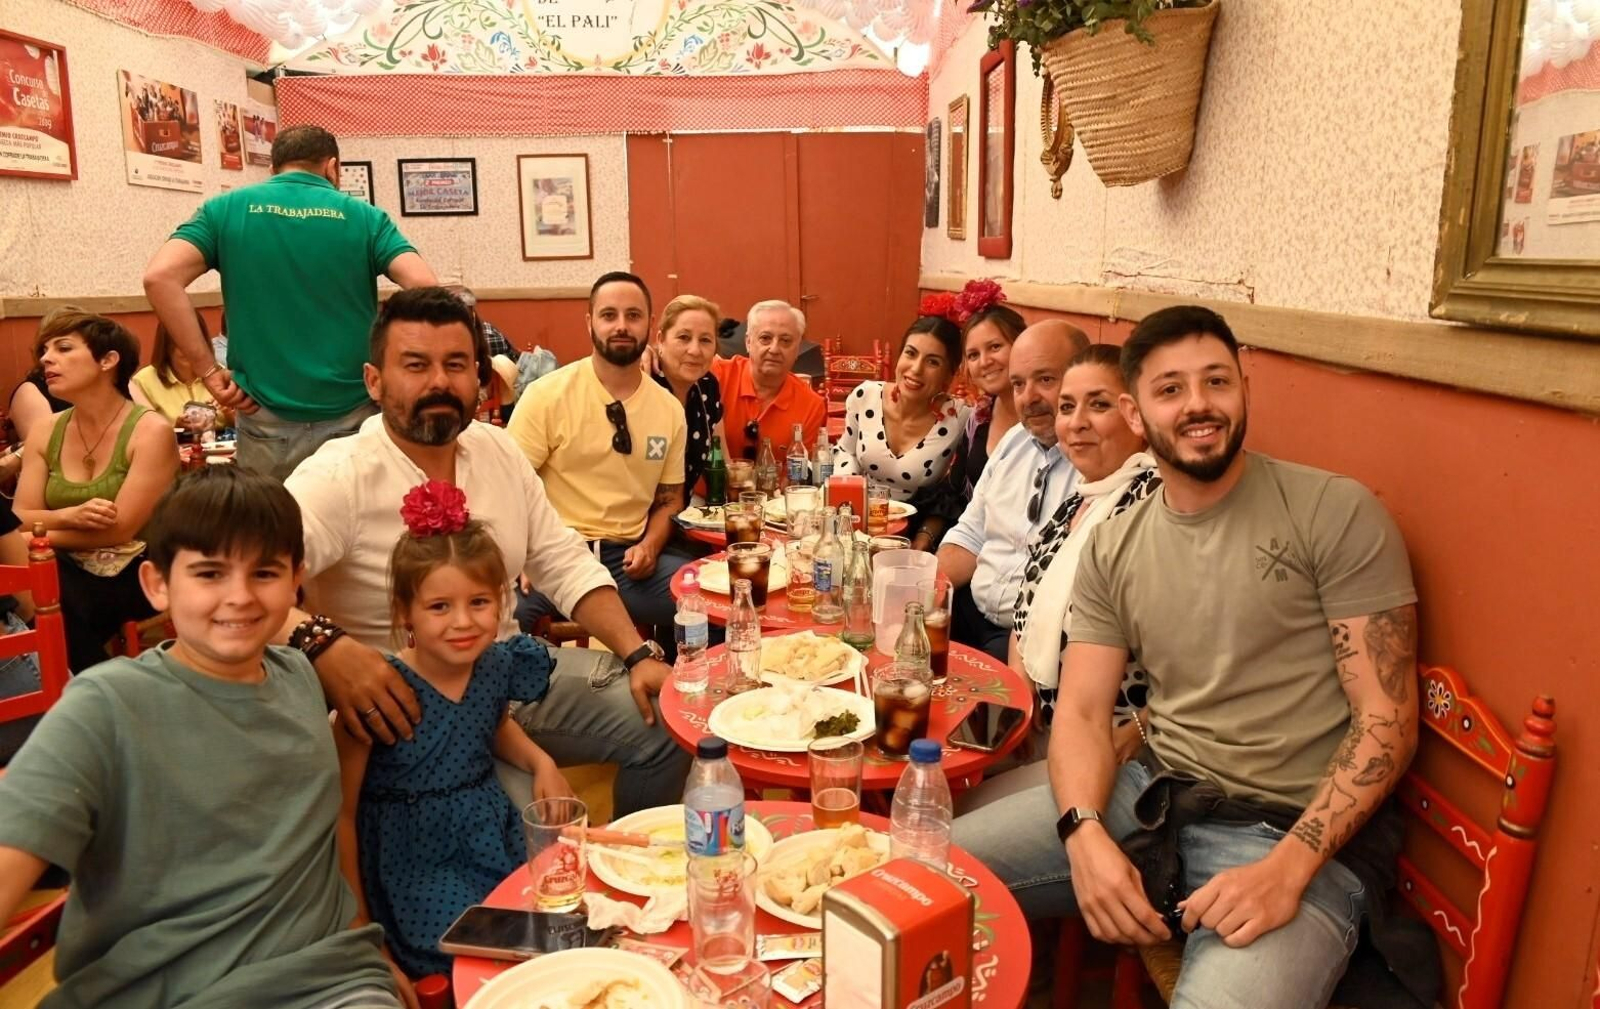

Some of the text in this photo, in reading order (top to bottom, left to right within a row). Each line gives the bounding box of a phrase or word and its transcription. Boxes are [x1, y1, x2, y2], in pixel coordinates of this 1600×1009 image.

[538, 15, 567, 28] "EL
[13, 87, 50, 110] Casetas
[437, 187, 469, 196] CASETA
[249, 204, 346, 220] LA TRABAJADERA
[870, 868, 934, 907] Cruzcampo
